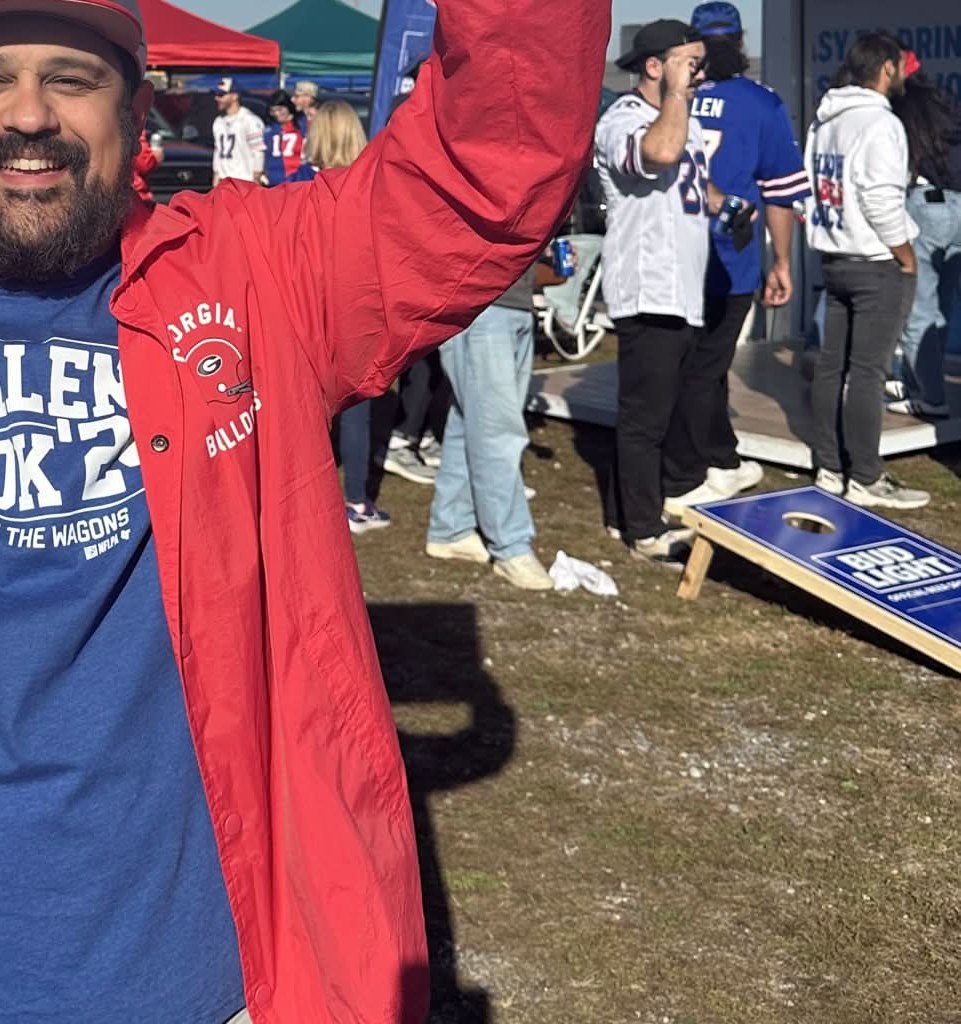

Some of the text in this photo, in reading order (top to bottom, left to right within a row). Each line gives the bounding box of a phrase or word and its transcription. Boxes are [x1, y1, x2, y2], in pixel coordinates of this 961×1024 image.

[691, 97, 724, 118] LEN
[220, 133, 236, 159] 17
[272, 133, 297, 157] 17
[7, 527, 46, 549] THE
[52, 507, 130, 548] WAGONS
[836, 545, 915, 571] BUD
[852, 556, 956, 588] LIGHT
